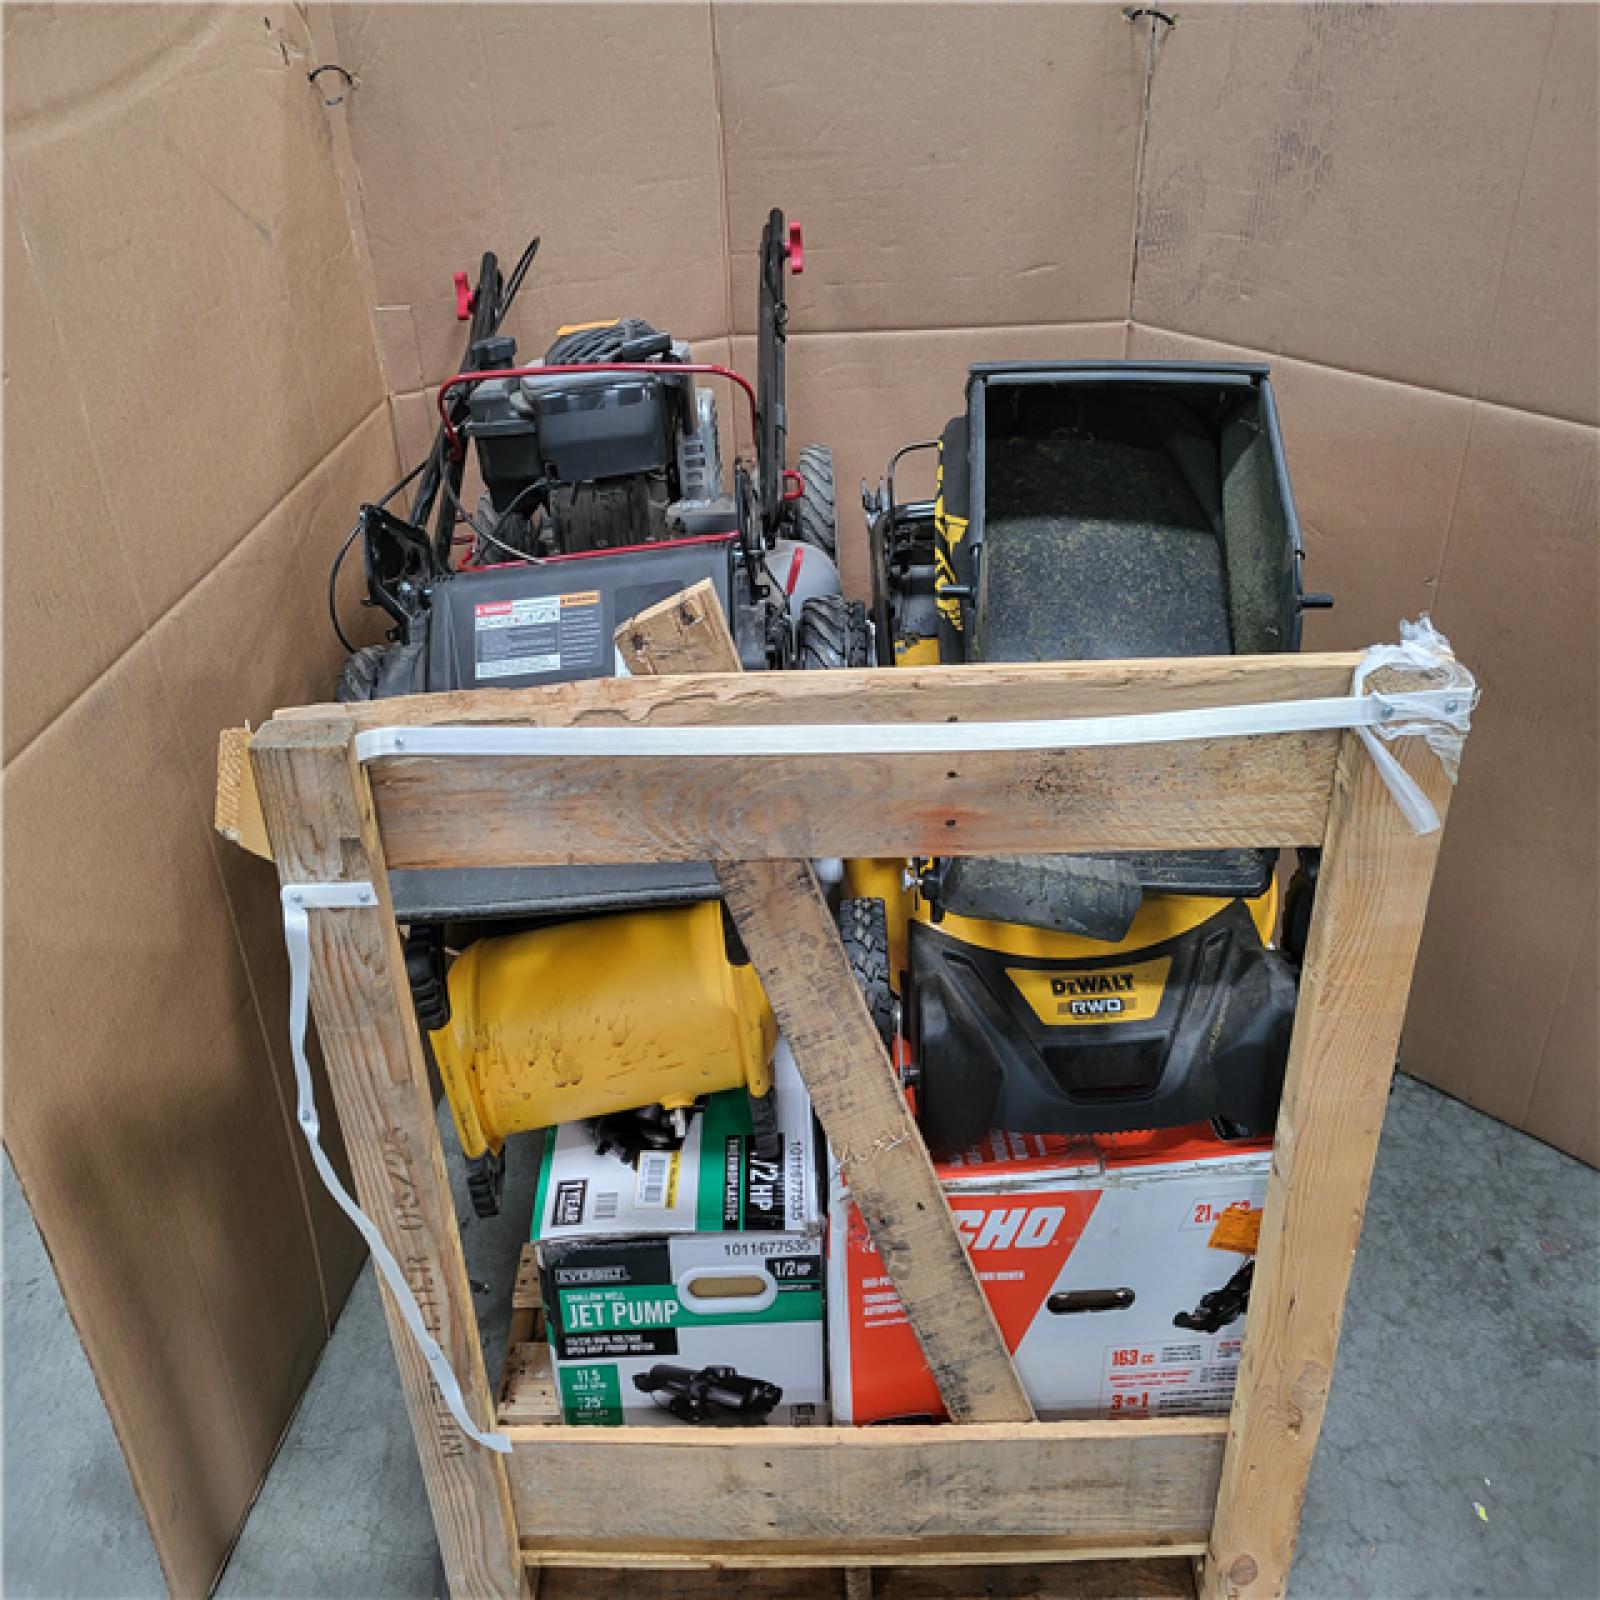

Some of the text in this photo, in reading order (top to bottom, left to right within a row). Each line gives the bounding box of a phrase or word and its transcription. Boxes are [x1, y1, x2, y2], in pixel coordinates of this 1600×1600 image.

[1070, 998, 1121, 1015] RWD
[1194, 1204, 1211, 1223] 21
[569, 1299, 679, 1329] JET PUMP
[1112, 1349, 1139, 1366] 163
